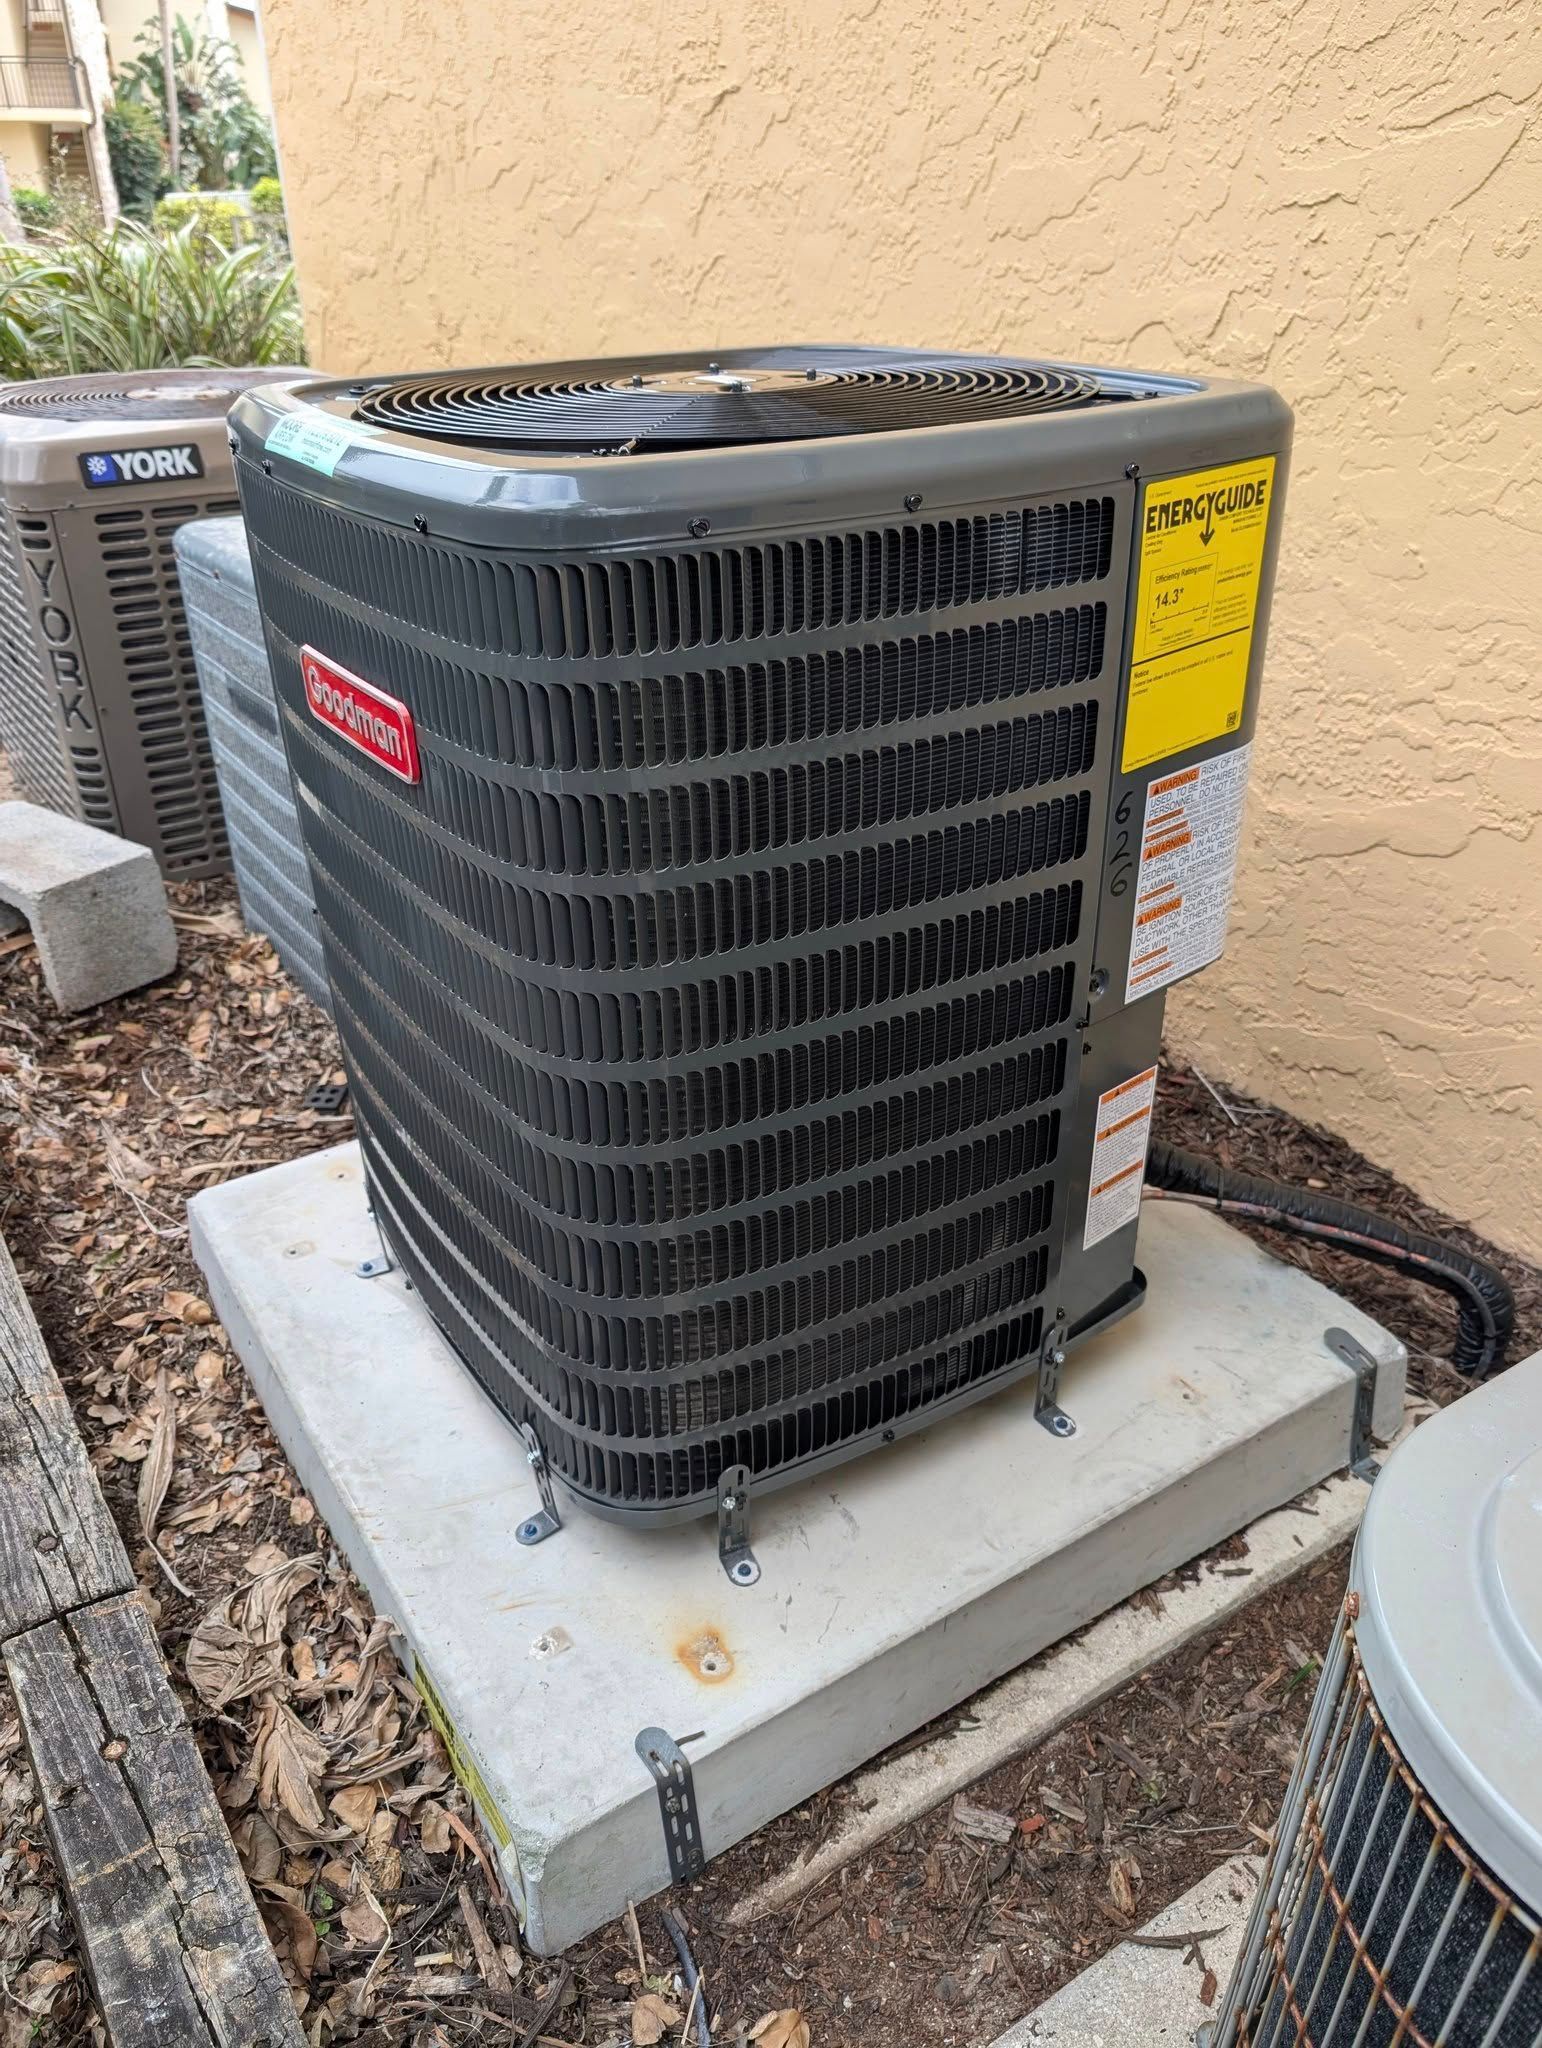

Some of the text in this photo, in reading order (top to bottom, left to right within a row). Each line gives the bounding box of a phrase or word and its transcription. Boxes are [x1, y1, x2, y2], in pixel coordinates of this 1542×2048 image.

[113, 447, 199, 480] YORK
[1145, 480, 1267, 534] ENERGYGUIDE
[1155, 571, 1180, 584] Efficiency
[26, 557, 94, 731] YORK
[308, 666, 402, 761] Goodman
[1159, 772, 1196, 791] WARNING
[1201, 762, 1219, 776] RISK
[1220, 756, 1231, 769] OF
[1176, 785, 1186, 797] TO
[1188, 780, 1198, 793] BE
[1200, 767, 1237, 787] REPAIRED
[1199, 787, 1210, 799] DO
[1212, 780, 1228, 794] NOT
[1152, 835, 1189, 855] WARNING
[1192, 825, 1209, 840] RISK
[1210, 819, 1221, 832] OF
[1142, 859, 1153, 872] OF
[1154, 844, 1194, 866] PROPERLY
[1196, 838, 1204, 849] IN
[1178, 854, 1190, 867] OR
[1191, 844, 1214, 861] LOCAL
[1140, 871, 1184, 894] FLAMMABLE
[1136, 924, 1146, 937] BE
[1148, 910, 1181, 930] IGNITION
[1182, 893, 1218, 914] SOURCES
[1144, 899, 1180, 921] WARNING
[1185, 889, 1201, 904] RISK
[1203, 882, 1214, 895] OF
[1181, 906, 1208, 925] OTHER
[1134, 945, 1149, 959] USE
[1151, 935, 1170, 951] WITH
[1172, 926, 1186, 941] THE
